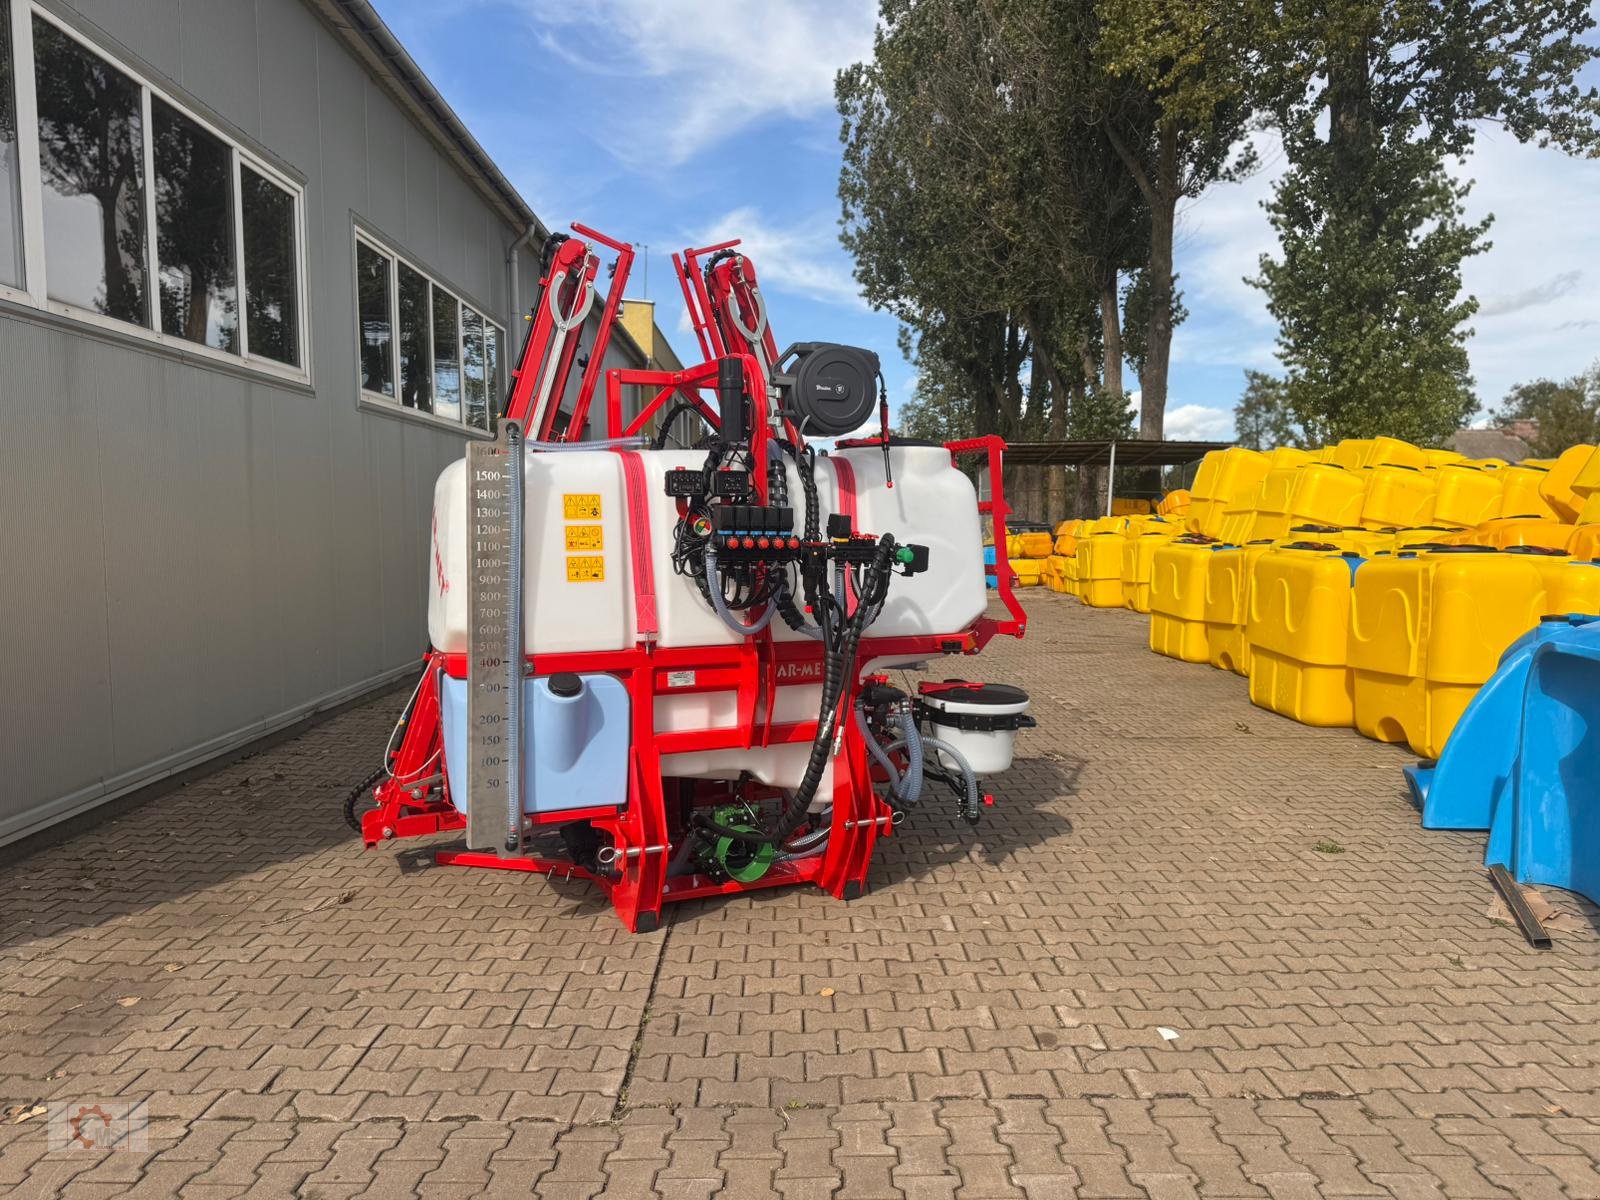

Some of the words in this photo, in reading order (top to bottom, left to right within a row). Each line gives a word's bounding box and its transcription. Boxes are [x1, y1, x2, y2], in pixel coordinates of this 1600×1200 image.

[476, 470, 500, 481] 1500
[476, 489, 500, 500] 1400
[476, 507, 500, 518] 1300
[476, 524, 500, 535] 1200
[476, 541, 500, 552] 1100
[476, 558, 500, 568] 1000
[479, 575, 500, 585] 900
[480, 591, 500, 602] 800
[480, 608, 500, 618] 700
[479, 624, 500, 634] 600
[479, 641, 500, 652] 500
[479, 657, 500, 668] 400
[480, 714, 500, 724] 200
[482, 735, 500, 745] 150
[481, 756, 500, 767] 100
[486, 778, 500, 789] 50
